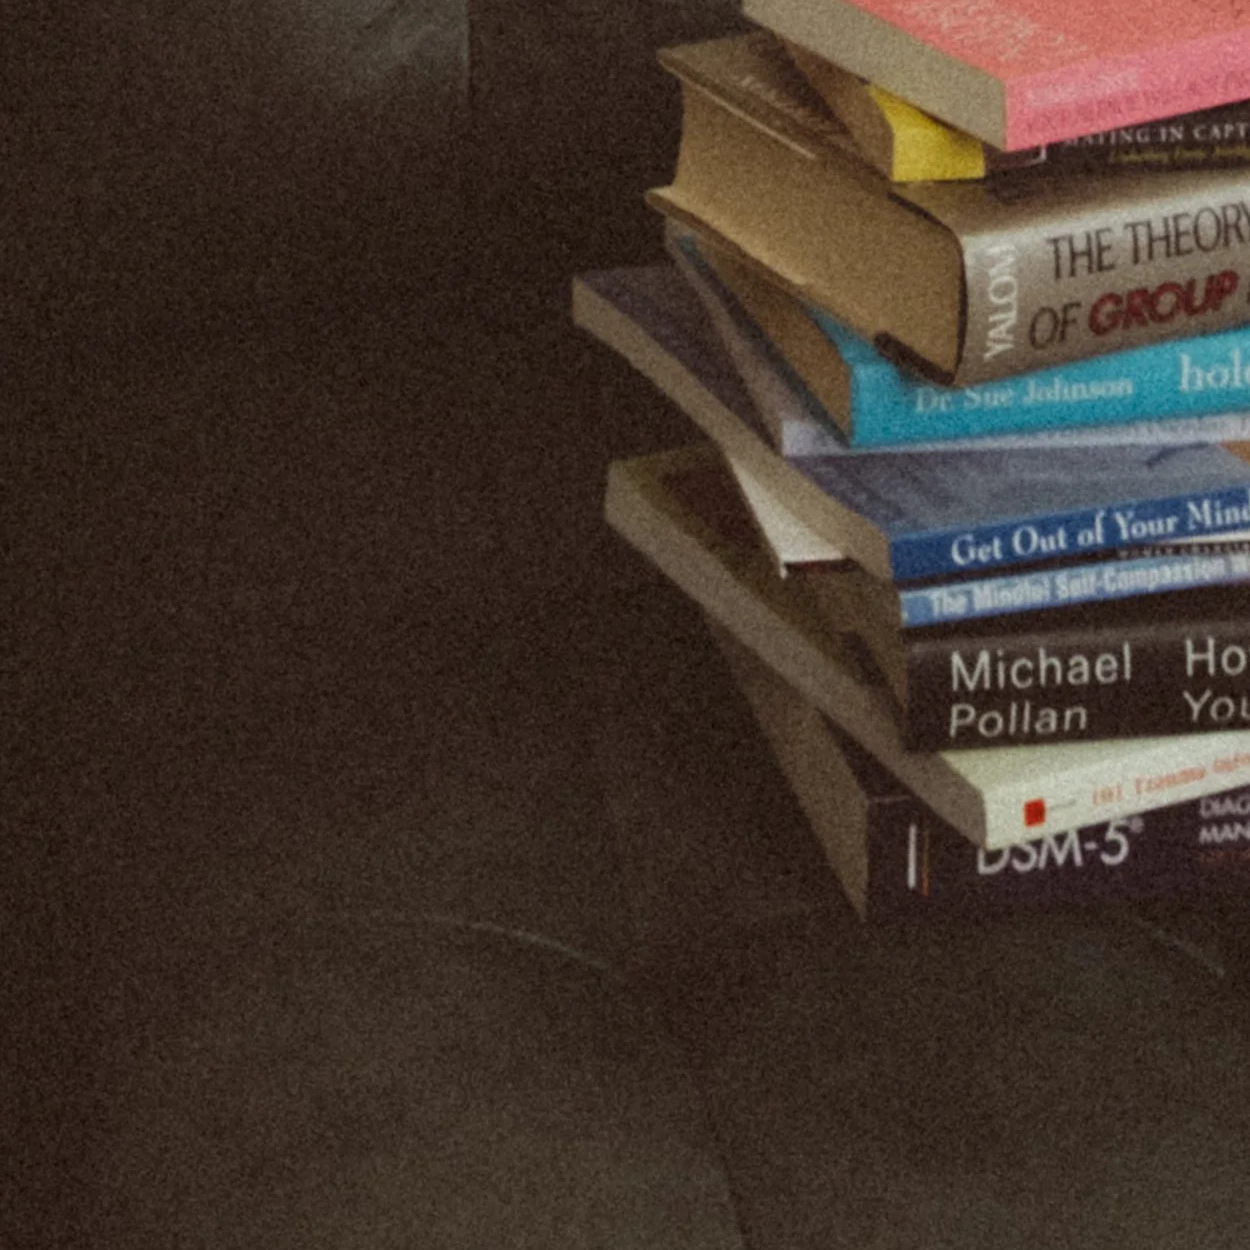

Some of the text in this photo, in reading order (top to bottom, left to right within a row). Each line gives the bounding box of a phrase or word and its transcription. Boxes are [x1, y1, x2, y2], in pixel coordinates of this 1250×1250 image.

[1160, 125, 1183, 142] IN
[1046, 226, 1116, 280] THE
[983, 241, 1018, 360] YALOM
[1029, 302, 1081, 350] OF
[1088, 271, 1239, 337] GROUP
[963, 386, 1014, 410] Sue
[1022, 375, 1134, 406] Johnson
[950, 534, 1002, 566] Get
[1012, 525, 1067, 556] Out
[1077, 509, 1106, 546] of
[1114, 509, 1178, 541] Your
[932, 588, 967, 617] The
[951, 641, 1131, 691] Michael
[950, 702, 1088, 737] Pollan
